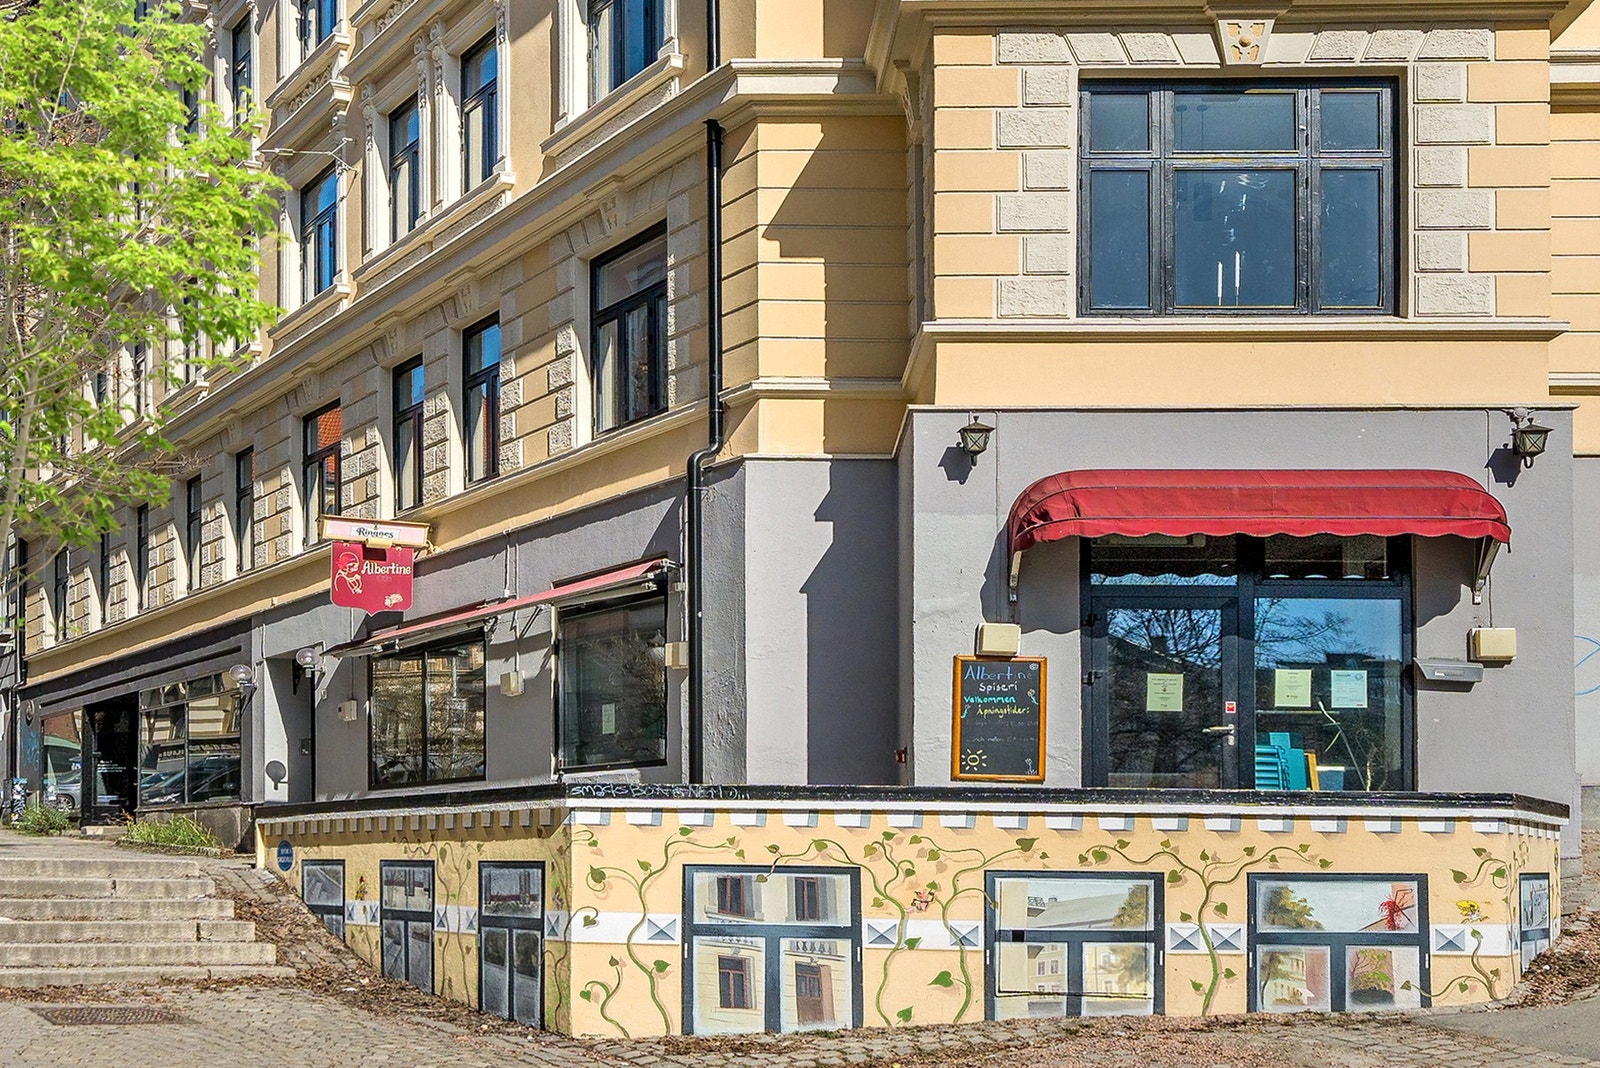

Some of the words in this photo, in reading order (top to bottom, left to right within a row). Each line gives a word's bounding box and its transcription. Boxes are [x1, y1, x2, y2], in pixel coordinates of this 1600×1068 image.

[356, 527, 394, 539] Ringnes
[361, 560, 412, 575] Albertine
[979, 681, 1018, 694] Spiseri
